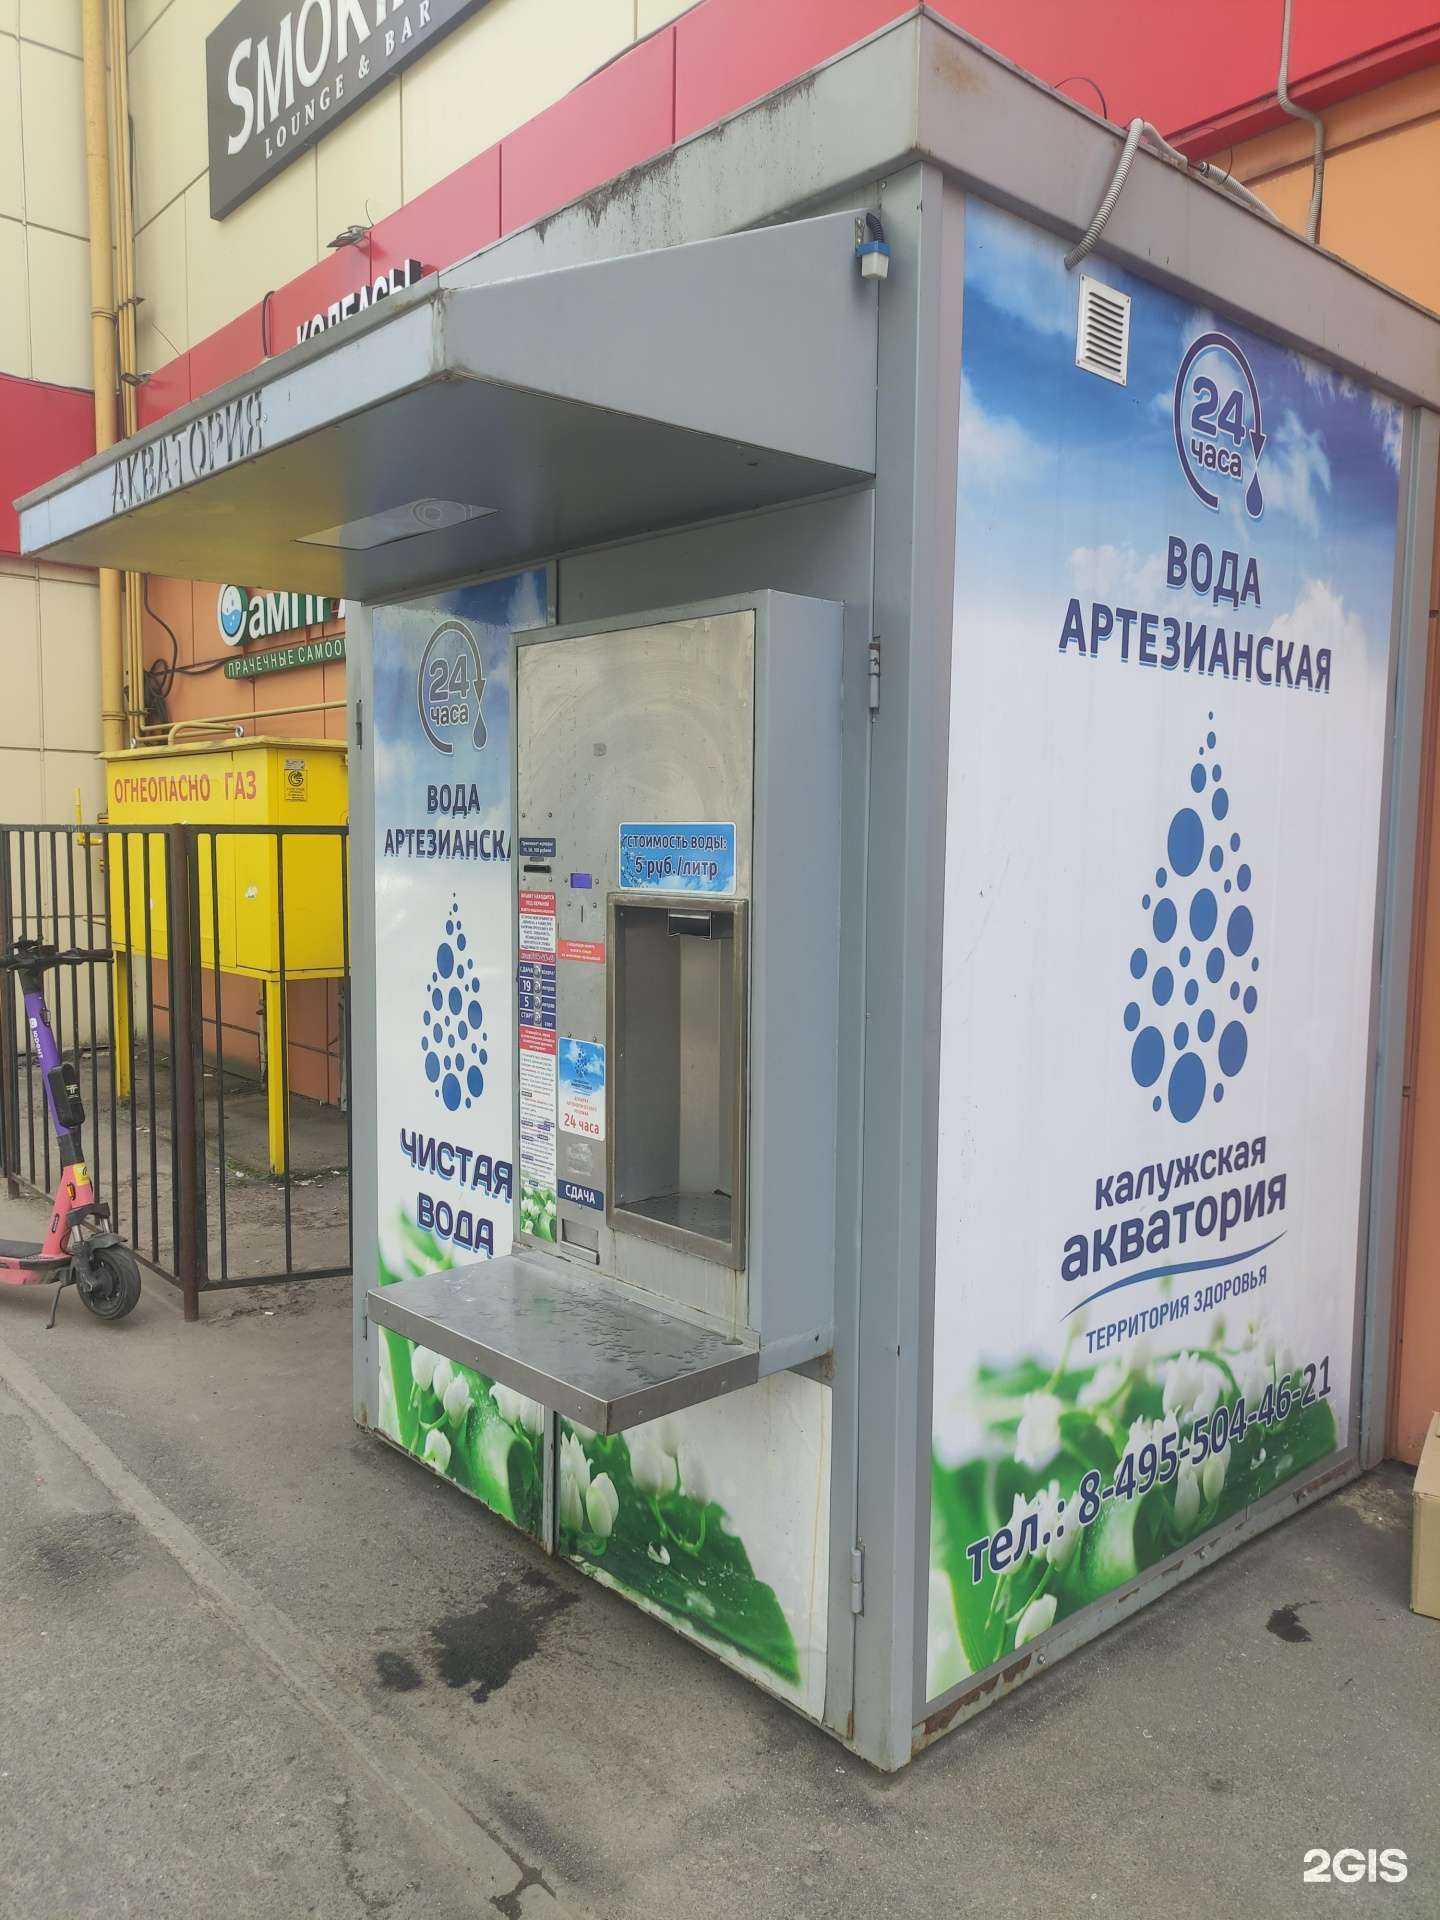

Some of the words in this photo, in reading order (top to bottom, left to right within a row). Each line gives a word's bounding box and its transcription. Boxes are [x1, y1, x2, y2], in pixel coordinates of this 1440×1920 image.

[227, 0, 405, 155] SMOK
[265, 74, 345, 159] LOUNGE
[358, 54, 370, 80] &
[384, 0, 431, 57] BAR
[1190, 375, 1247, 447] 24
[112, 388, 264, 513] АКВАТОРИЯ
[1190, 437, 1243, 480] часа
[1166, 535, 1261, 608] ВОДА
[228, 650, 295, 678] ПРАЧЕЧНЫЕ
[298, 639, 347, 663] САМОО
[1058, 597, 1332, 693] АРТЕЗИАНСКАЯ
[429, 655, 470, 702] 24
[429, 703, 470, 727] часа
[114, 774, 211, 803] ОГНЕОПАСНО
[224, 769, 257, 801] ГАЗ
[426, 783, 481, 818] ВОДА
[634, 856, 643, 874] 5
[522, 980, 532, 992] 19
[524, 996, 530, 1008] 5
[564, 1112, 577, 1129] 24
[578, 1121, 600, 1135] часа
[400, 1127, 513, 1204] ЧИСТАЯ
[565, 1184, 596, 1204] СДАЧА
[1095, 1136, 1267, 1211] калужская
[417, 1191, 494, 1259] ВОДА
[1086, 1295, 1190, 1354] ТЕРРИТОРИЯ
[1193, 1264, 1268, 1314] ЗДОРОВЬЯ
[966, 1499, 1066, 1584] тел.:
[1078, 1355, 1332, 1529] 8-495-504-46-21
